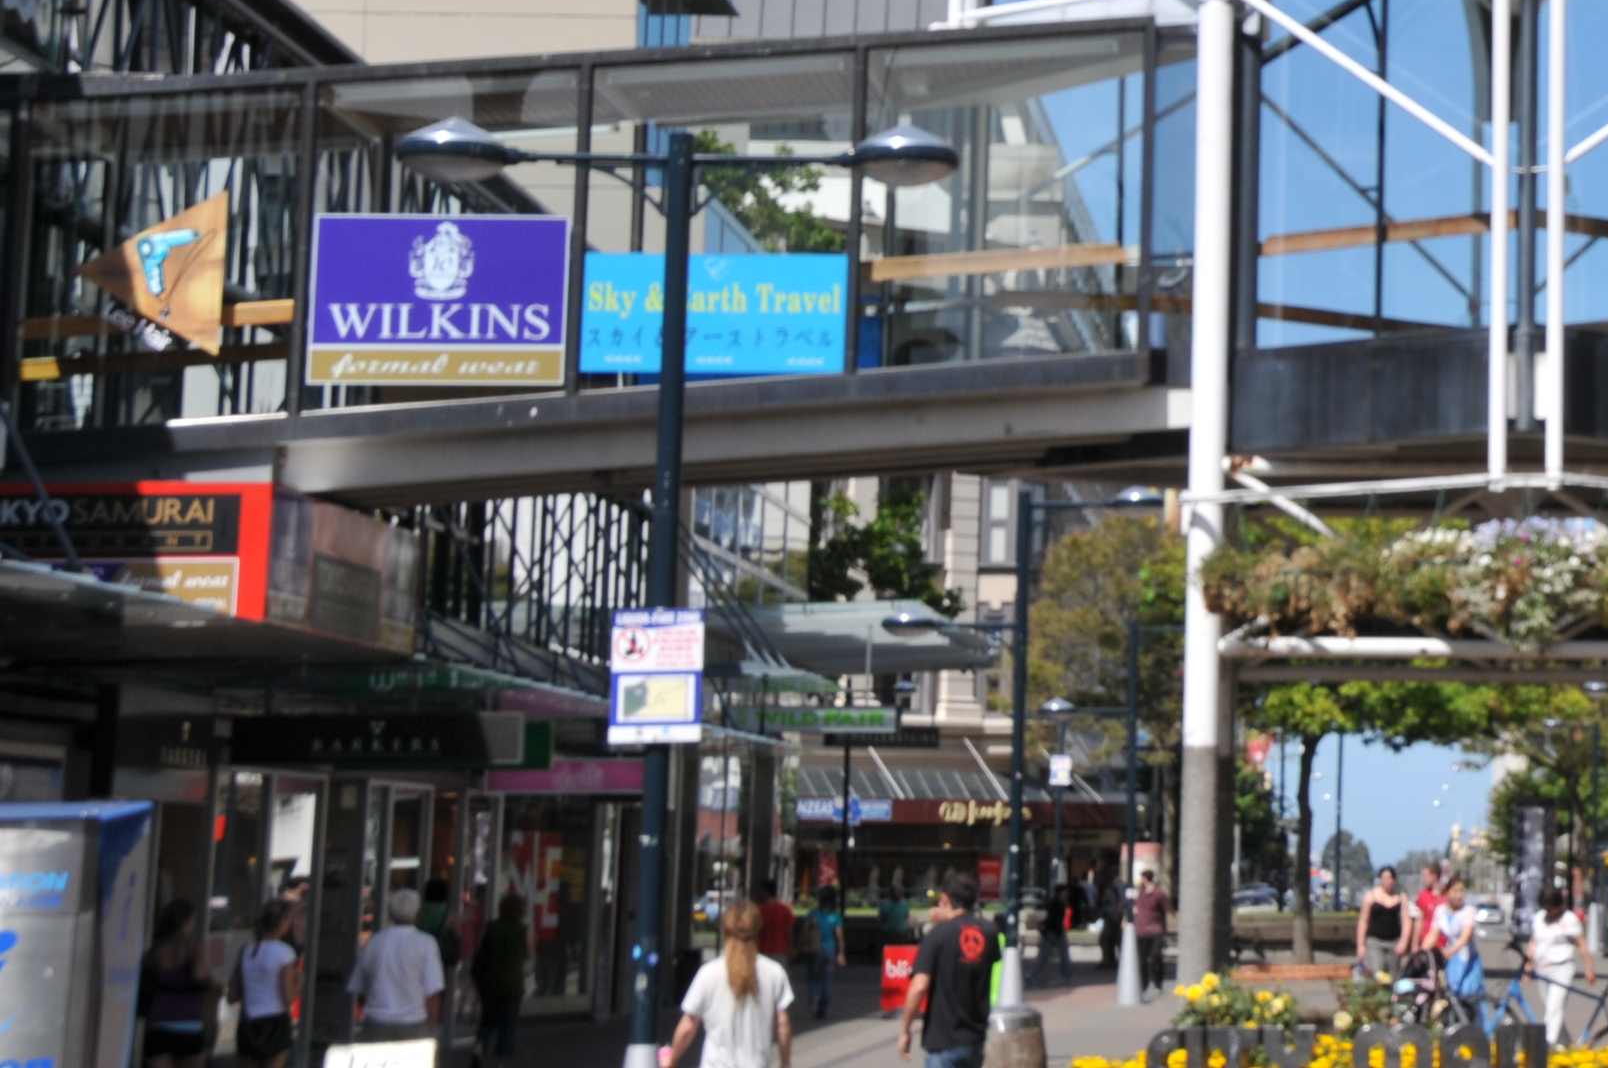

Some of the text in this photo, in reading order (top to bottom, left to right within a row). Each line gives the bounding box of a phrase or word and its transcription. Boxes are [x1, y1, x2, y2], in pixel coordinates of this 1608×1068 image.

[588, 282, 637, 319] Sky
[685, 282, 747, 313] arth
[756, 283, 841, 314] Travel
[327, 302, 551, 341] WILKINS
[331, 352, 542, 379] formal wear
